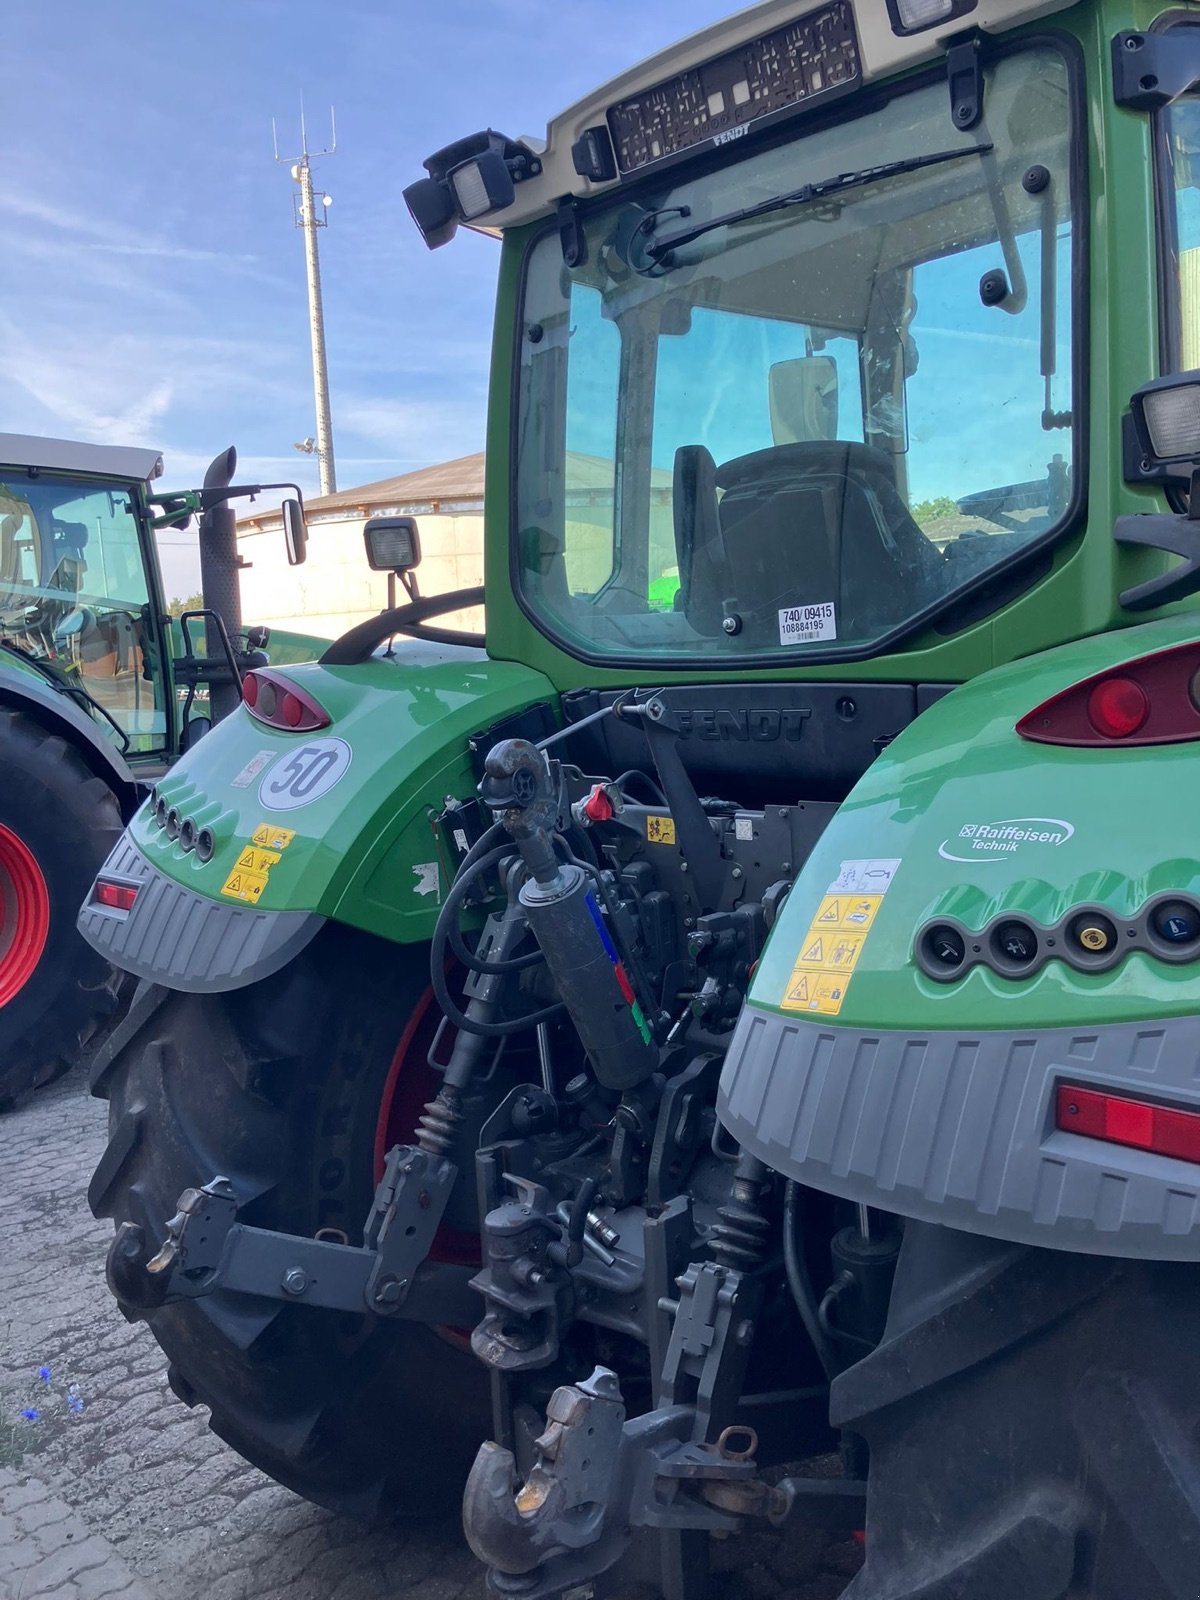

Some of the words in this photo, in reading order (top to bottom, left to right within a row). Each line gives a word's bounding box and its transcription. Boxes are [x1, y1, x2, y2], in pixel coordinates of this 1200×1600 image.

[713, 122, 750, 147] FENDT
[672, 709, 812, 741] FENDT
[269, 747, 339, 798] 50
[971, 838, 1019, 852] Technik
[975, 825, 1062, 843] Raiffeisen
